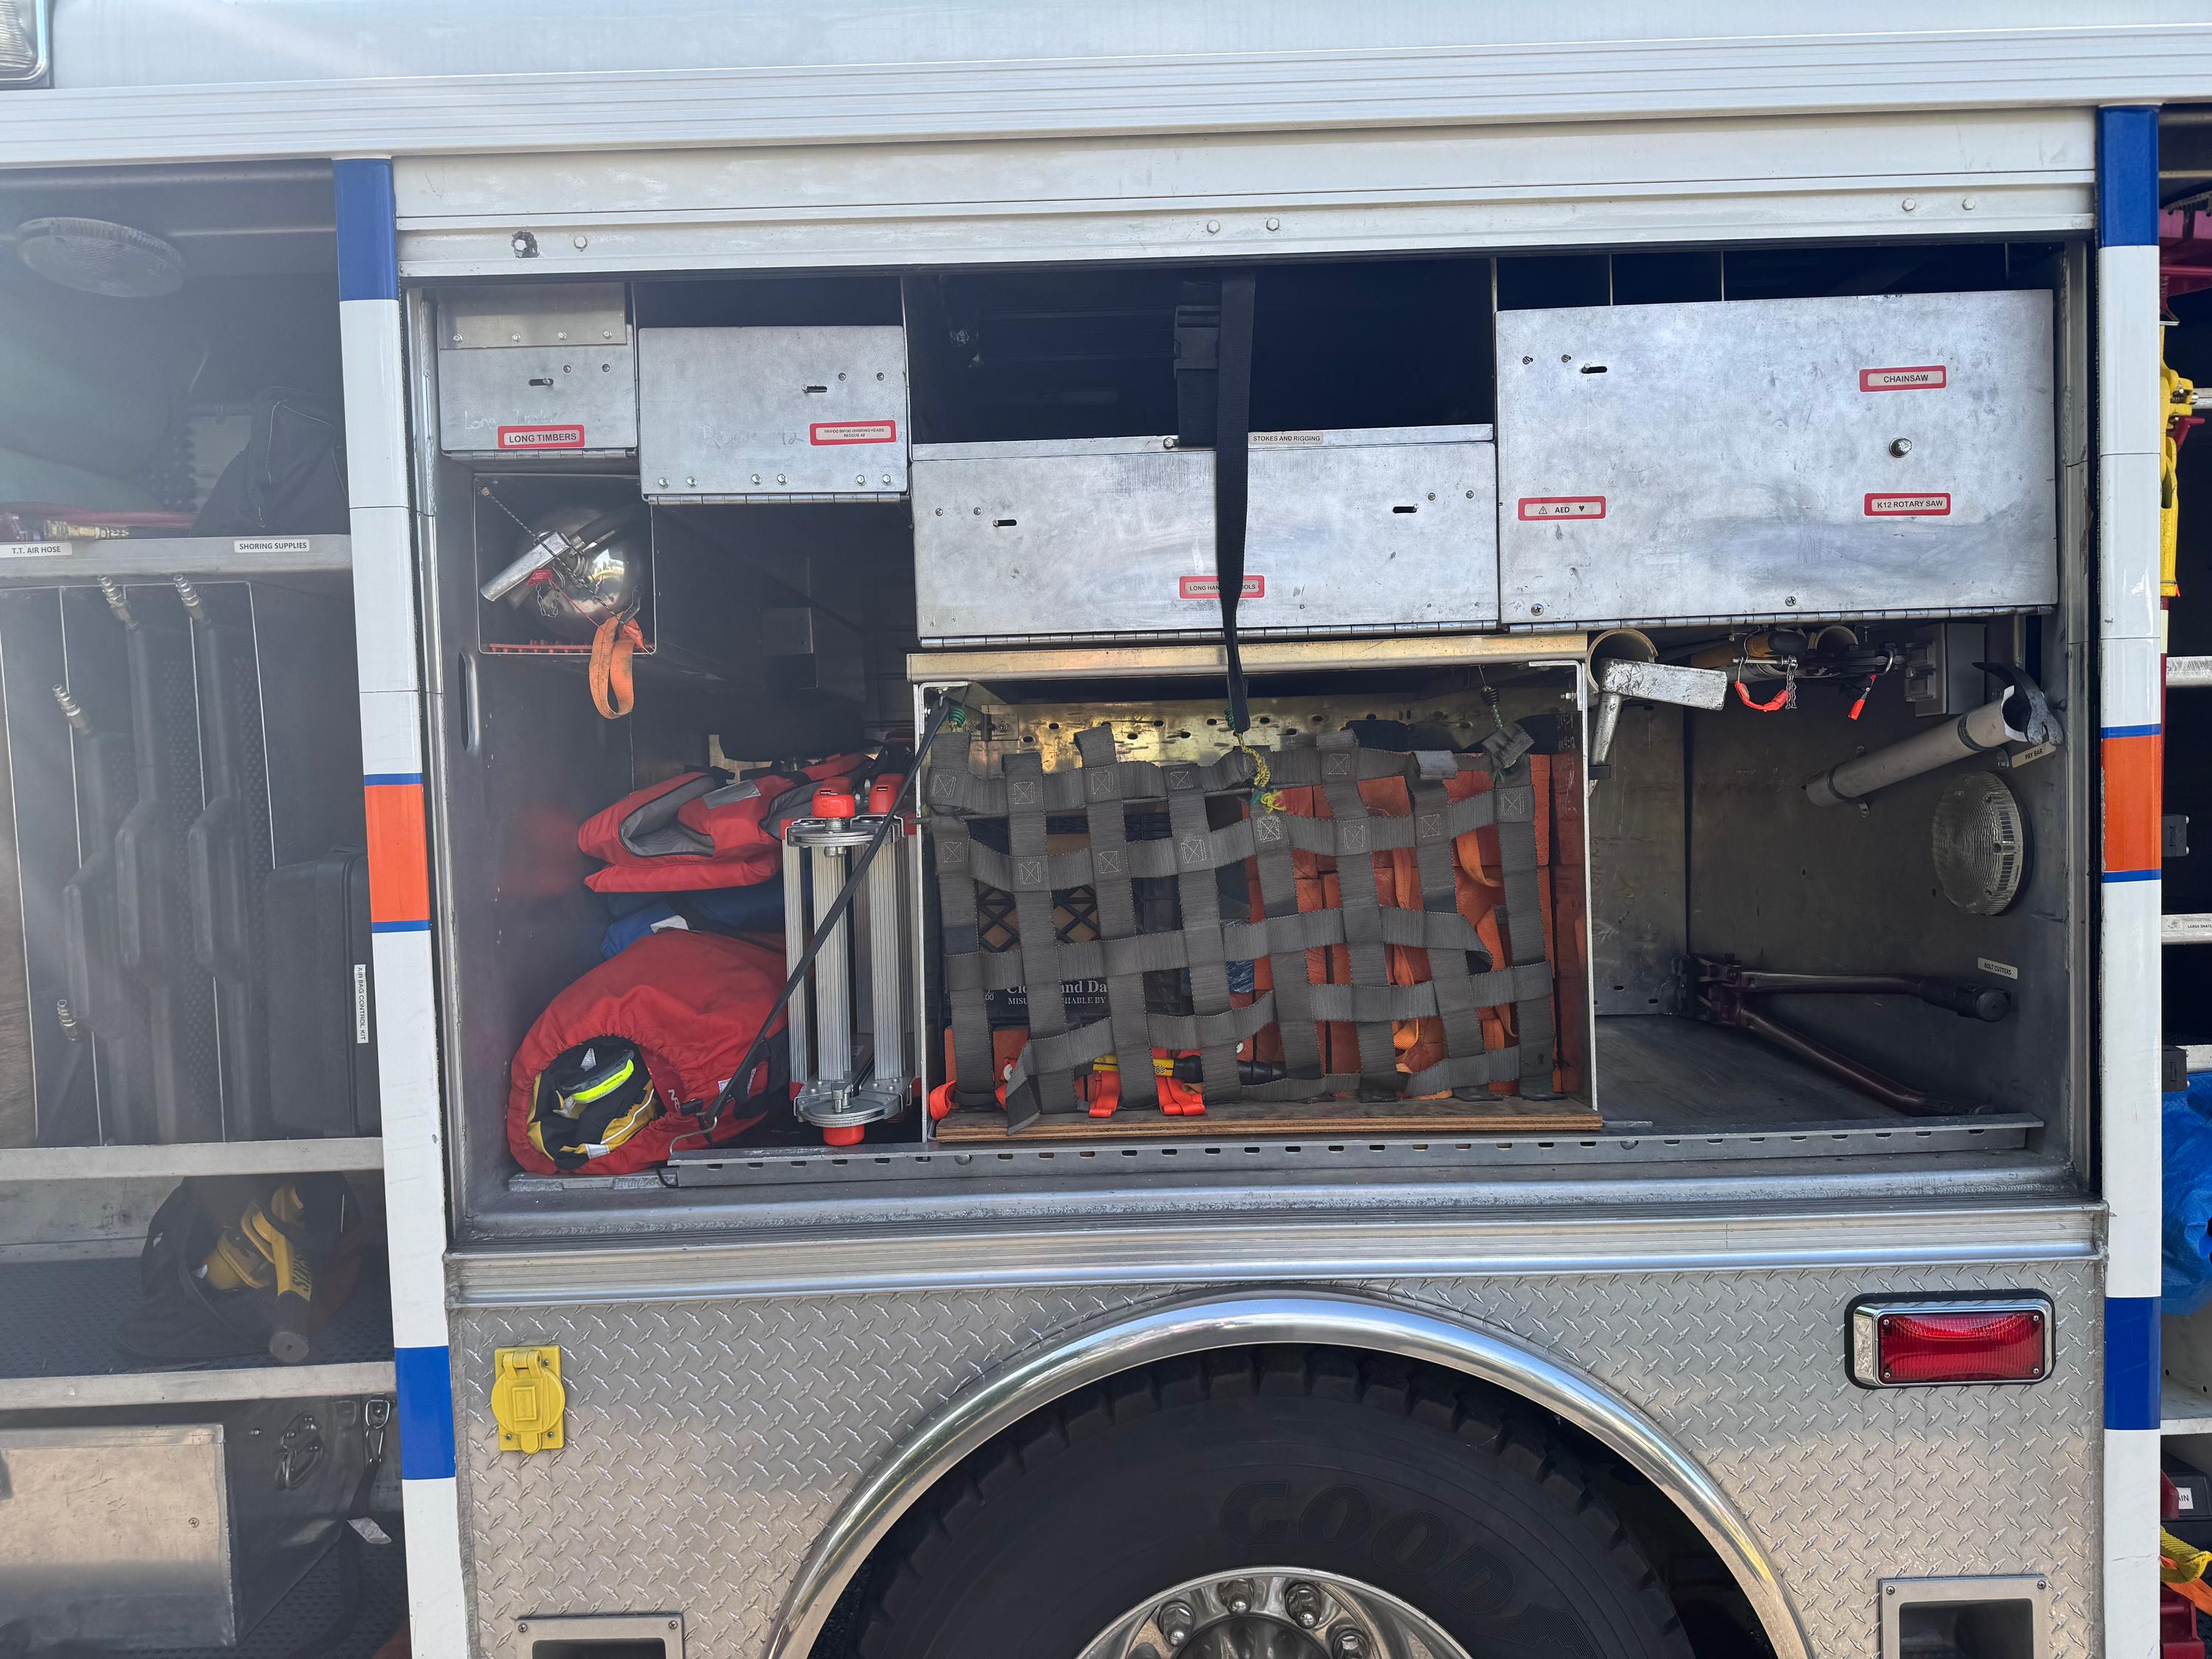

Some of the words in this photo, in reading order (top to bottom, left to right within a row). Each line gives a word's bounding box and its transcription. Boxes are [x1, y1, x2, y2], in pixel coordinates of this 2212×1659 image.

[1883, 374, 1929, 383] CHAINSAW
[509, 435, 535, 443] LONG
[537, 433, 577, 442] TIMBERS
[2025, 752, 2033, 760] PRY
[2034, 748, 2043, 757] BAR
